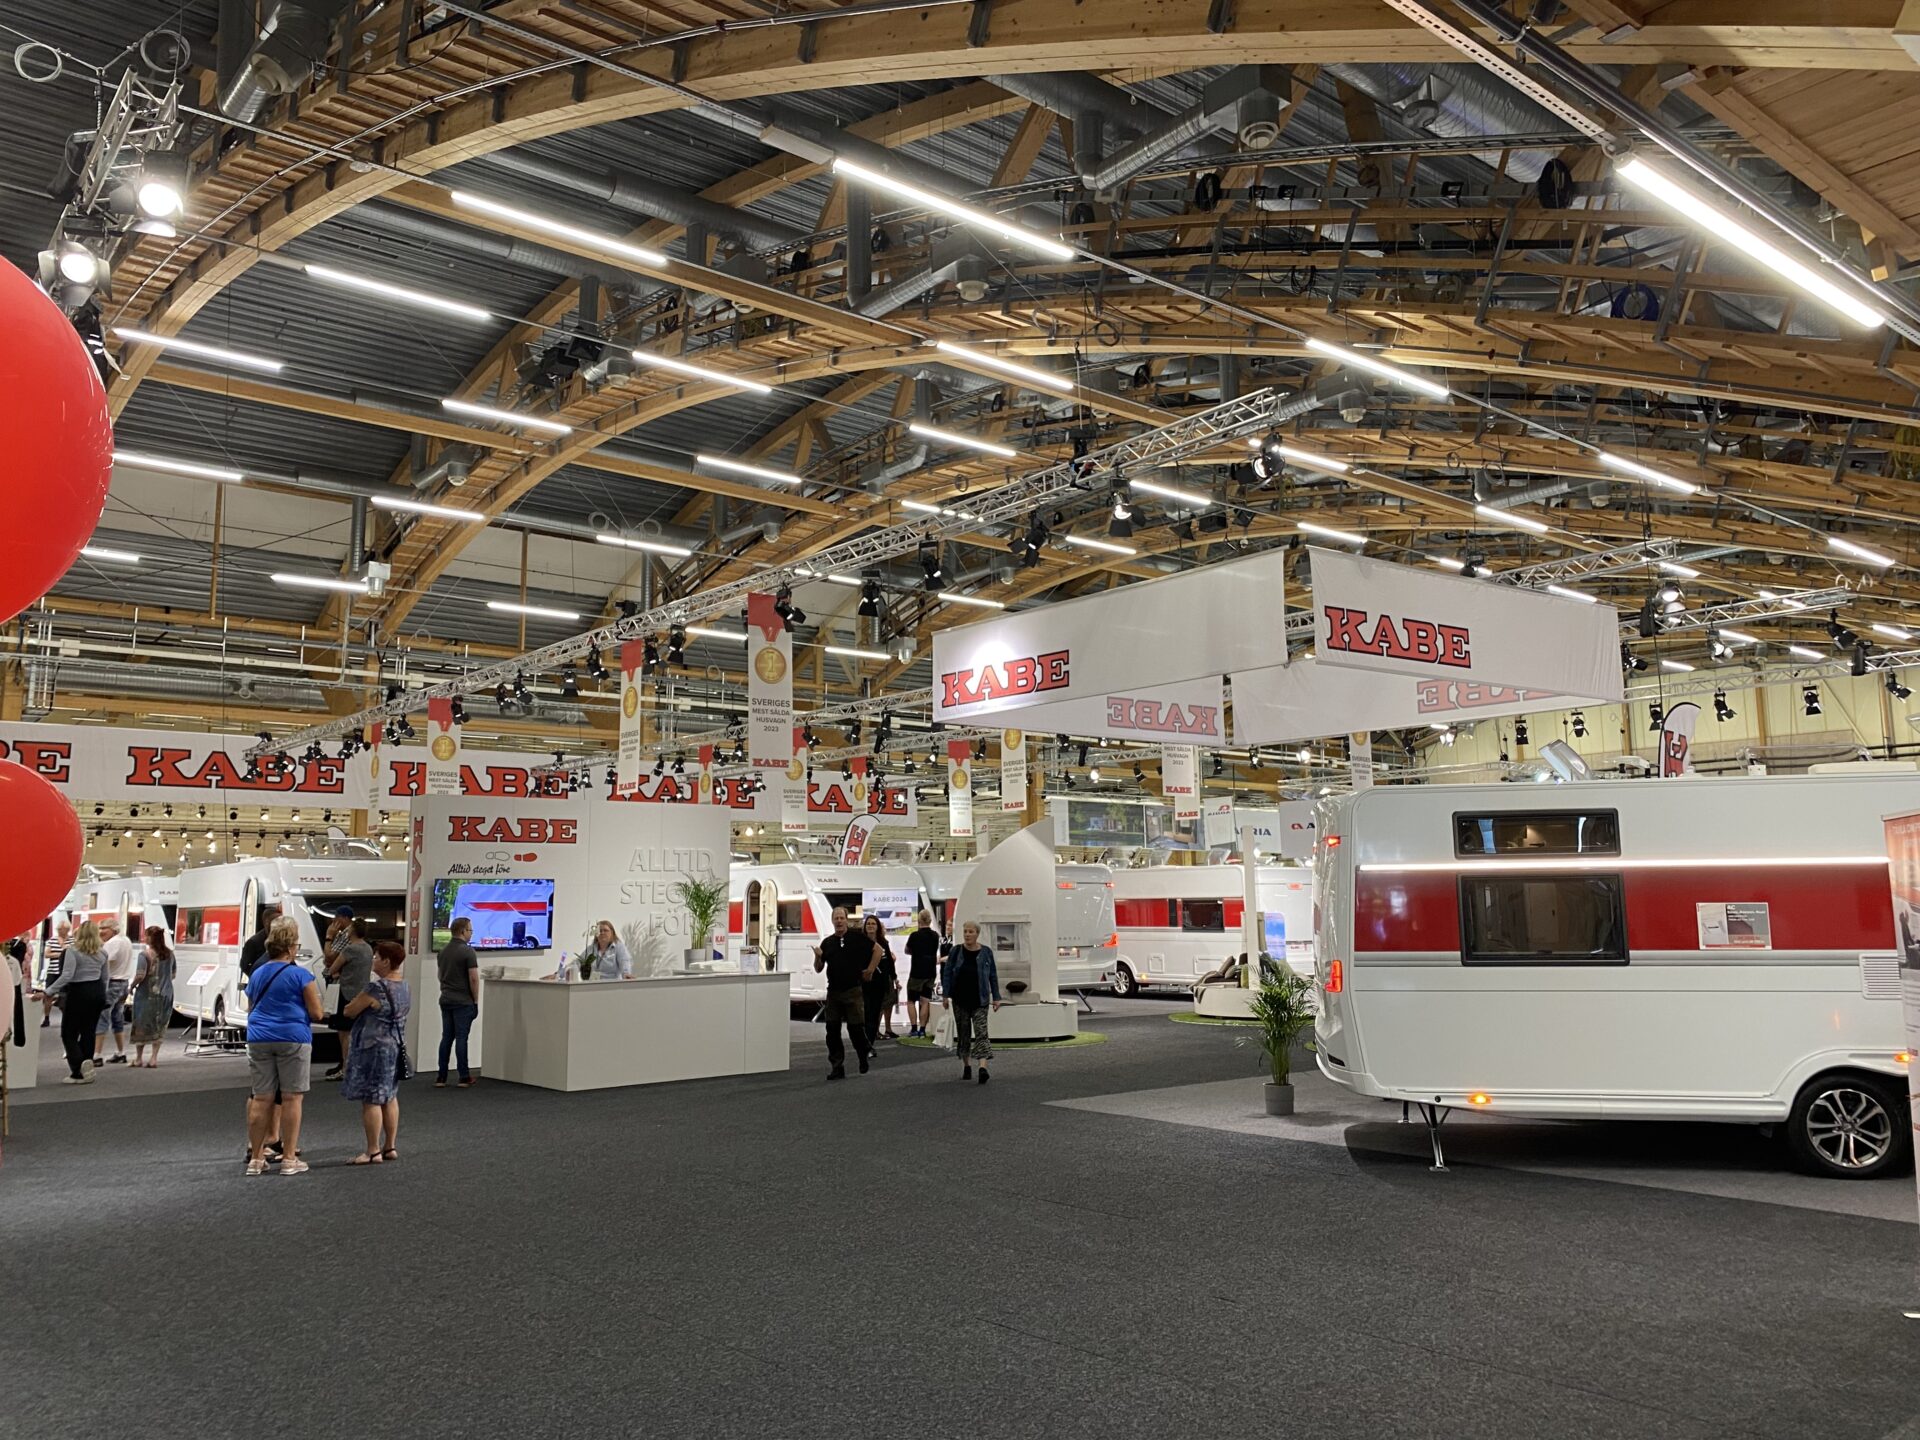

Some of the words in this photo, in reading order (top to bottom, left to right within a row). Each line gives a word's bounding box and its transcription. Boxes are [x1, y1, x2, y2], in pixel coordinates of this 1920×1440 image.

[1325, 605, 1471, 669] KABE
[942, 649, 1069, 708] KABE
[752, 698, 791, 708] SVERIGES
[770, 708, 790, 716] SÅLDA
[126, 746, 345, 794] KABE
[752, 758, 789, 768] KABE
[389, 761, 568, 799] KABE
[1166, 786, 1192, 794] KABE
[448, 816, 577, 843] KABE
[448, 864, 471, 875] Alltid
[473, 865, 493, 875] steget
[496, 863, 511, 875] före
[628, 848, 714, 873] ALLTID
[409, 816, 424, 955] KABE
[620, 880, 684, 905] STEG
